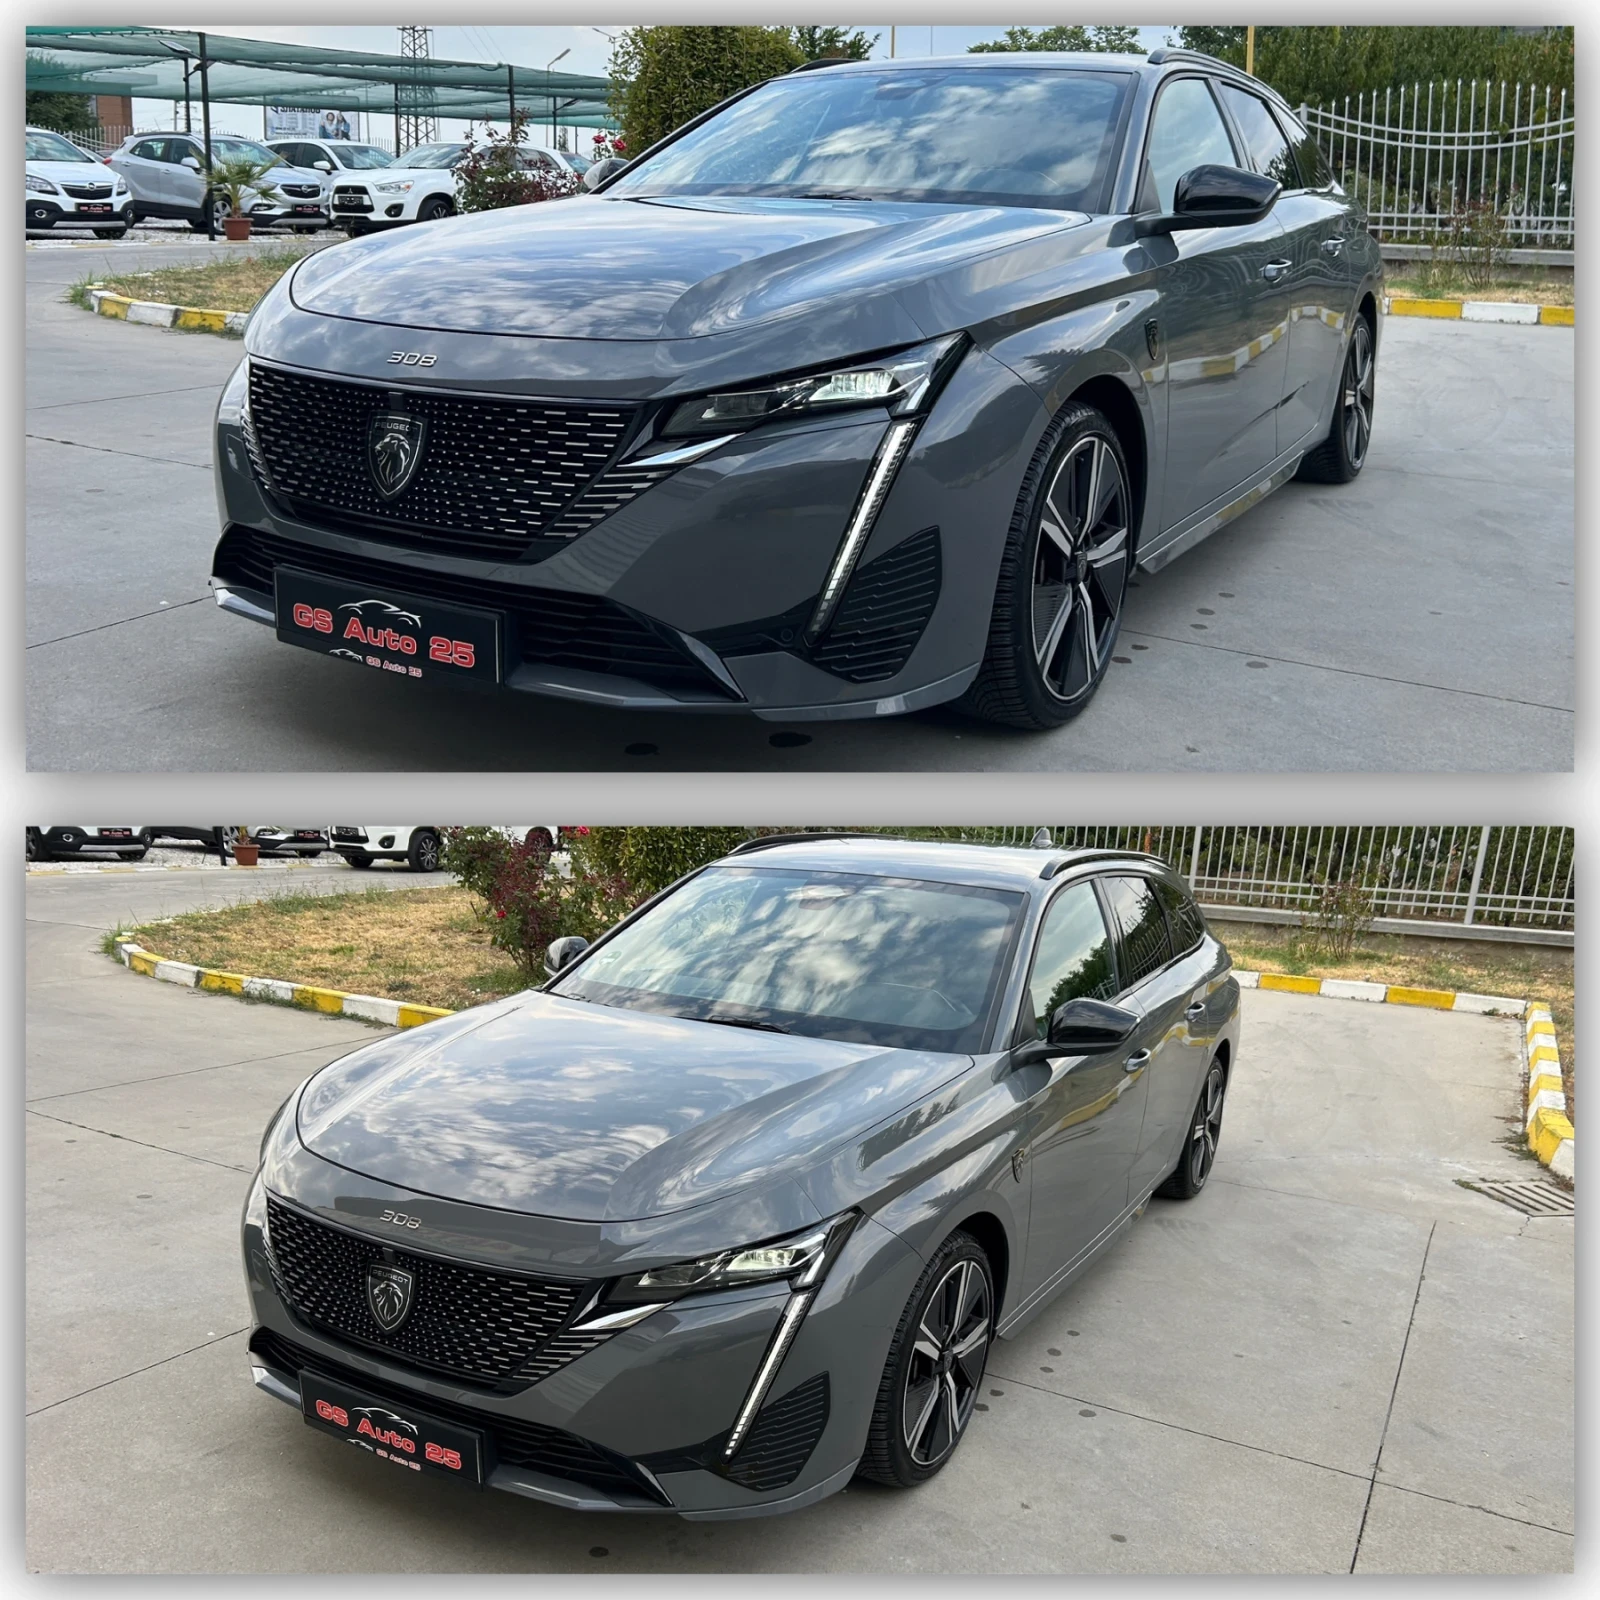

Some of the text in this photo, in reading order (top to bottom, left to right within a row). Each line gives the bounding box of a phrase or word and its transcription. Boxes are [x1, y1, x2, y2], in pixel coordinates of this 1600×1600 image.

[387, 351, 437, 366] 308
[293, 603, 475, 668] GS Auto 25
[366, 655, 423, 677] GS Auto 25
[380, 1209, 421, 1229] 308
[316, 1400, 462, 1470] GS Auto 25
